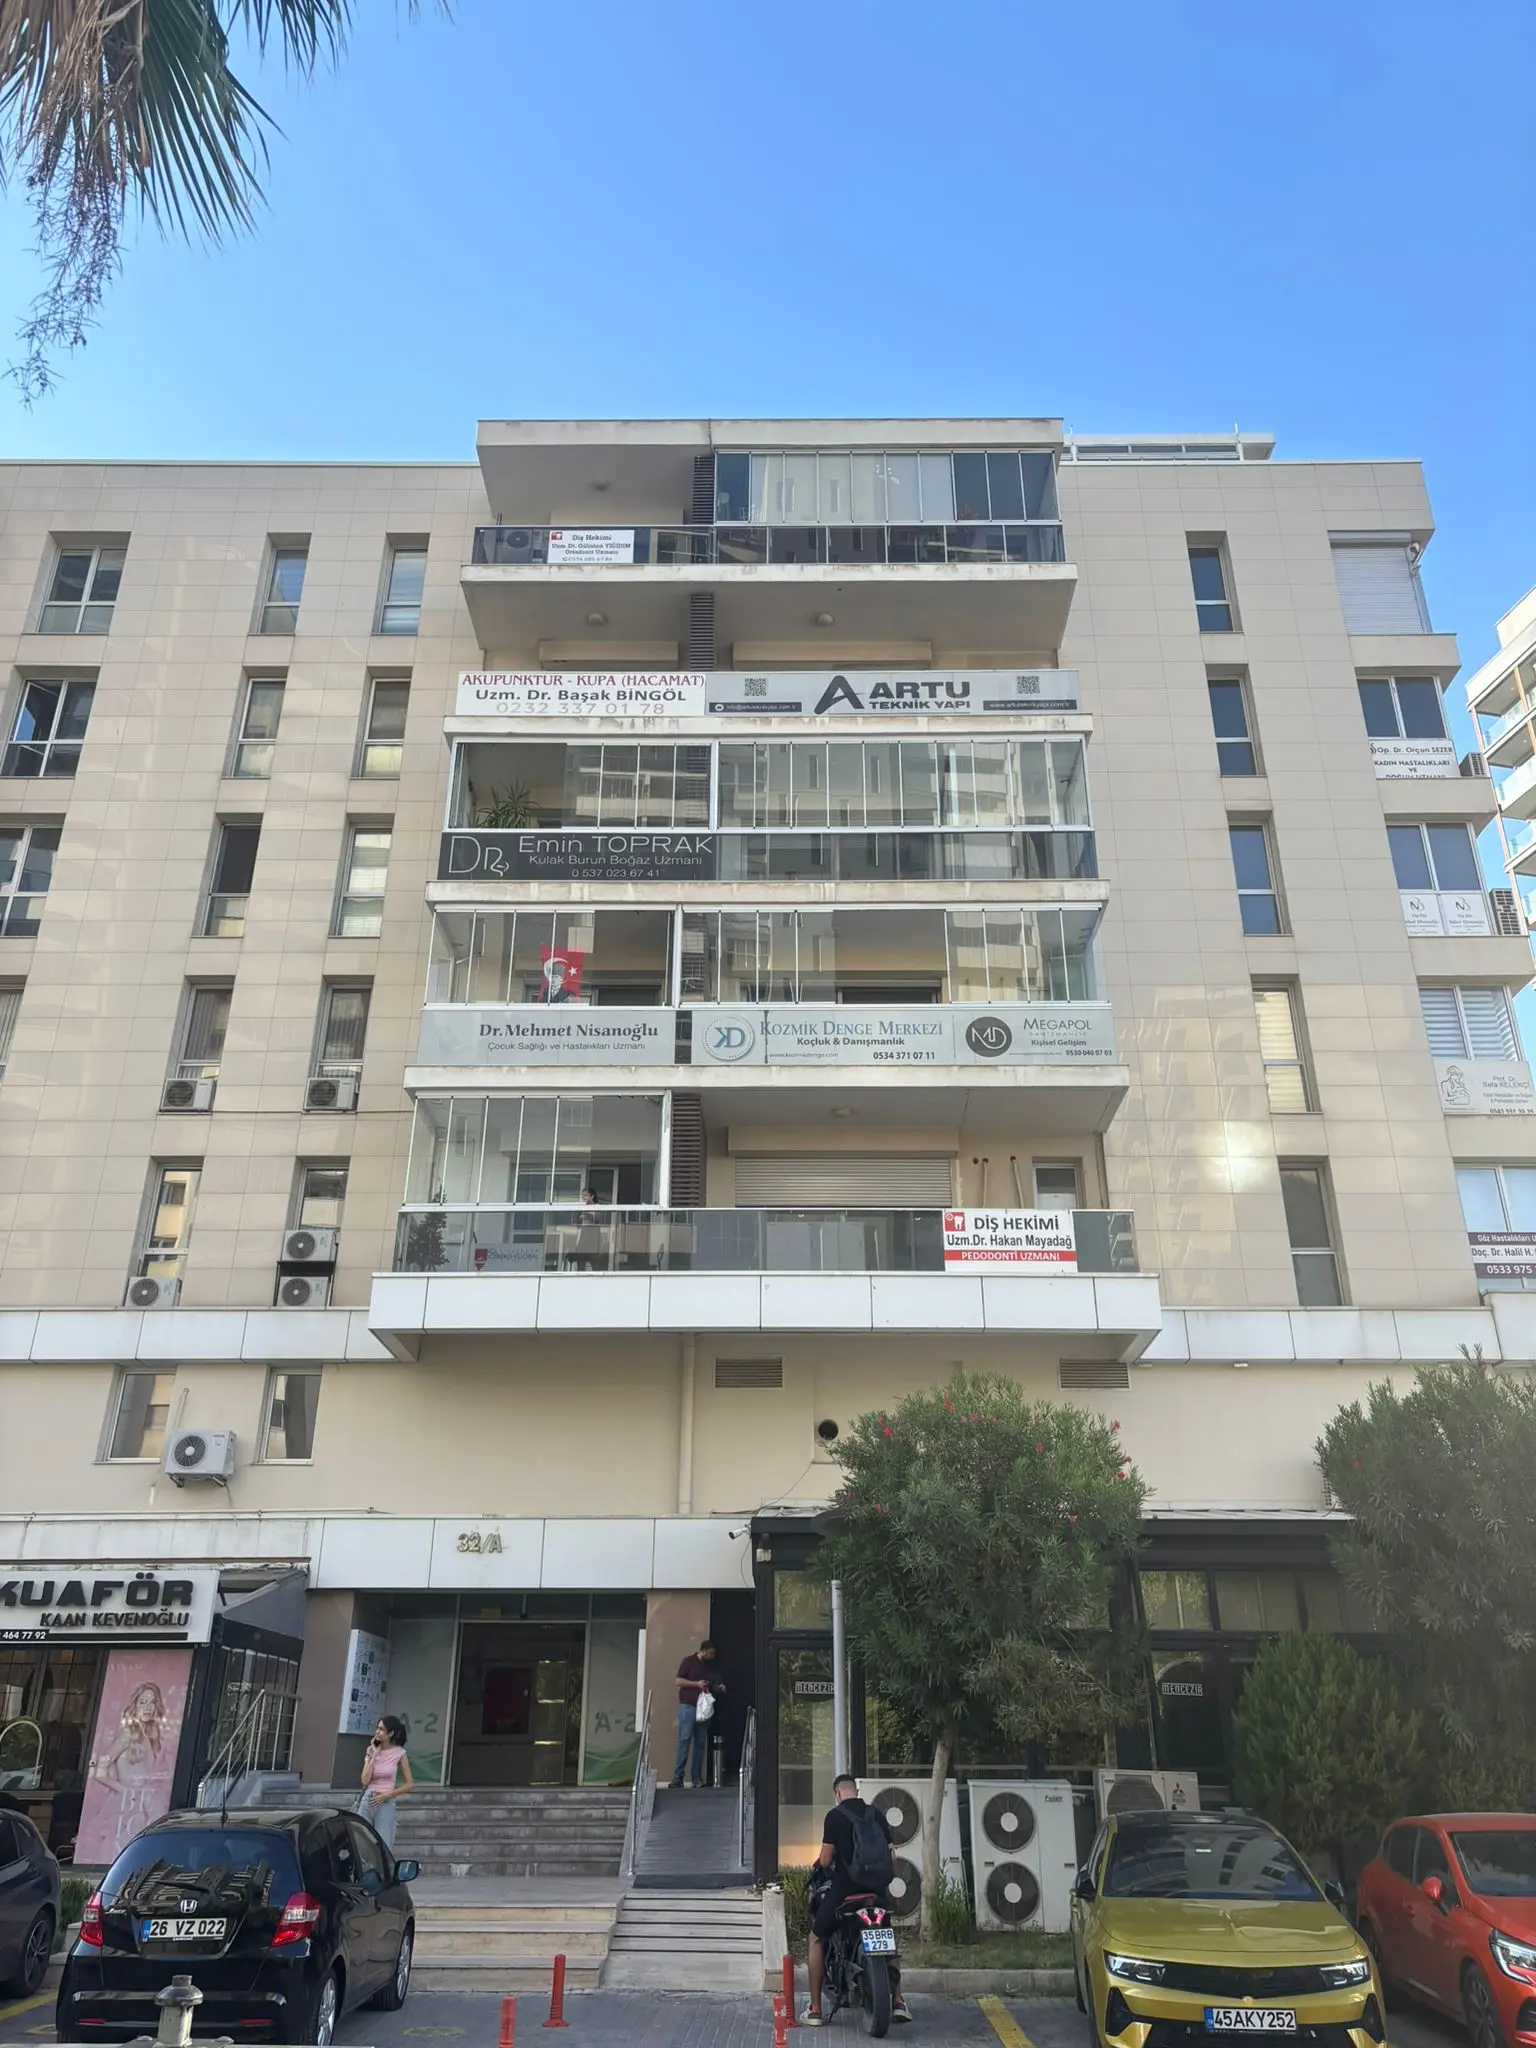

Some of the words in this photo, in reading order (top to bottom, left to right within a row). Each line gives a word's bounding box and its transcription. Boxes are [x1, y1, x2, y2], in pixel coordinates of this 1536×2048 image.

[462, 675, 563, 686] AKUPUNKTUR
[576, 675, 616, 686] KUPA
[621, 674, 705, 688] (HACAMAT)
[476, 689, 520, 700] Uzm.
[527, 689, 551, 700] Dr.
[558, 689, 611, 703] Başak
[616, 688, 686, 700] BİNGÖL
[869, 682, 970, 699] ARTU
[496, 703, 548, 714] 0232
[558, 703, 596, 714] 337
[605, 704, 628, 714] 01
[640, 703, 664, 714] 78
[869, 699, 930, 709] TEKNİK
[936, 700, 970, 709] YAPI
[519, 834, 582, 853] Emin
[592, 836, 712, 853] TOPRAK
[529, 855, 565, 865] Kulak
[569, 855, 606, 865] Burun
[610, 855, 650, 867] Boğaz
[655, 855, 702, 865] Uzmanı
[572, 869, 579, 877] 0
[582, 869, 603, 877] 537
[606, 869, 626, 877] 023
[630, 869, 644, 877] 67
[646, 869, 660, 877] 41
[760, 1020, 819, 1036] KOZMİK
[823, 1021, 873, 1036] DENGE
[878, 1020, 943, 1036] MERKEZİ
[1023, 1018, 1092, 1030] MEGAPOL
[576, 1023, 658, 1041] Nisanoğlu
[488, 1042, 516, 1052] Çocuk
[518, 1042, 547, 1052] Sağlığı
[563, 1042, 610, 1050] Hastalıkları
[612, 1042, 646, 1050] Uzmanı
[797, 1037, 831, 1047] Koçluk
[843, 1037, 905, 1047] Danışmanlık
[873, 1052, 894, 1060] 0534
[896, 1052, 911, 1060] 371
[913, 1052, 924, 1060] 07
[926, 1052, 936, 1060] 11
[974, 1214, 999, 1232] DİŞ
[1003, 1215, 1059, 1230] HEKİMİ
[947, 1235, 988, 1247] Uzm.Dr.
[991, 1234, 1022, 1246] Hakan
[1026, 1235, 1072, 1250] Mayadağ
[961, 1250, 1018, 1260] PEDODONTİ
[1020, 1251, 1060, 1261] UZMANI
[1472, 1248, 1490, 1258] Doç.
[1492, 1248, 1503, 1256] Dr.
[1505, 1248, 1524, 1256] Halil
[1525, 1248, 1534, 1256] H.
[1487, 1265, 1512, 1274] 0533
[1514, 1265, 1533, 1274] 975
[458, 1532, 502, 1554] 32/A
[0, 1572, 194, 1607] KUAFÖR
[40, 1613, 87, 1627] KAAN
[92, 1608, 189, 1627] KEVENOĞLU
[2, 1631, 20, 1640] 464
[22, 1631, 33, 1639] 77
[35, 1631, 46, 1639] 92
[150, 1920, 168, 1936] 26
[176, 1920, 196, 1936] VZ
[198, 1920, 225, 1935] 022
[872, 1940, 888, 1950] 279
[1215, 2010, 1295, 2028] 45AKY252
